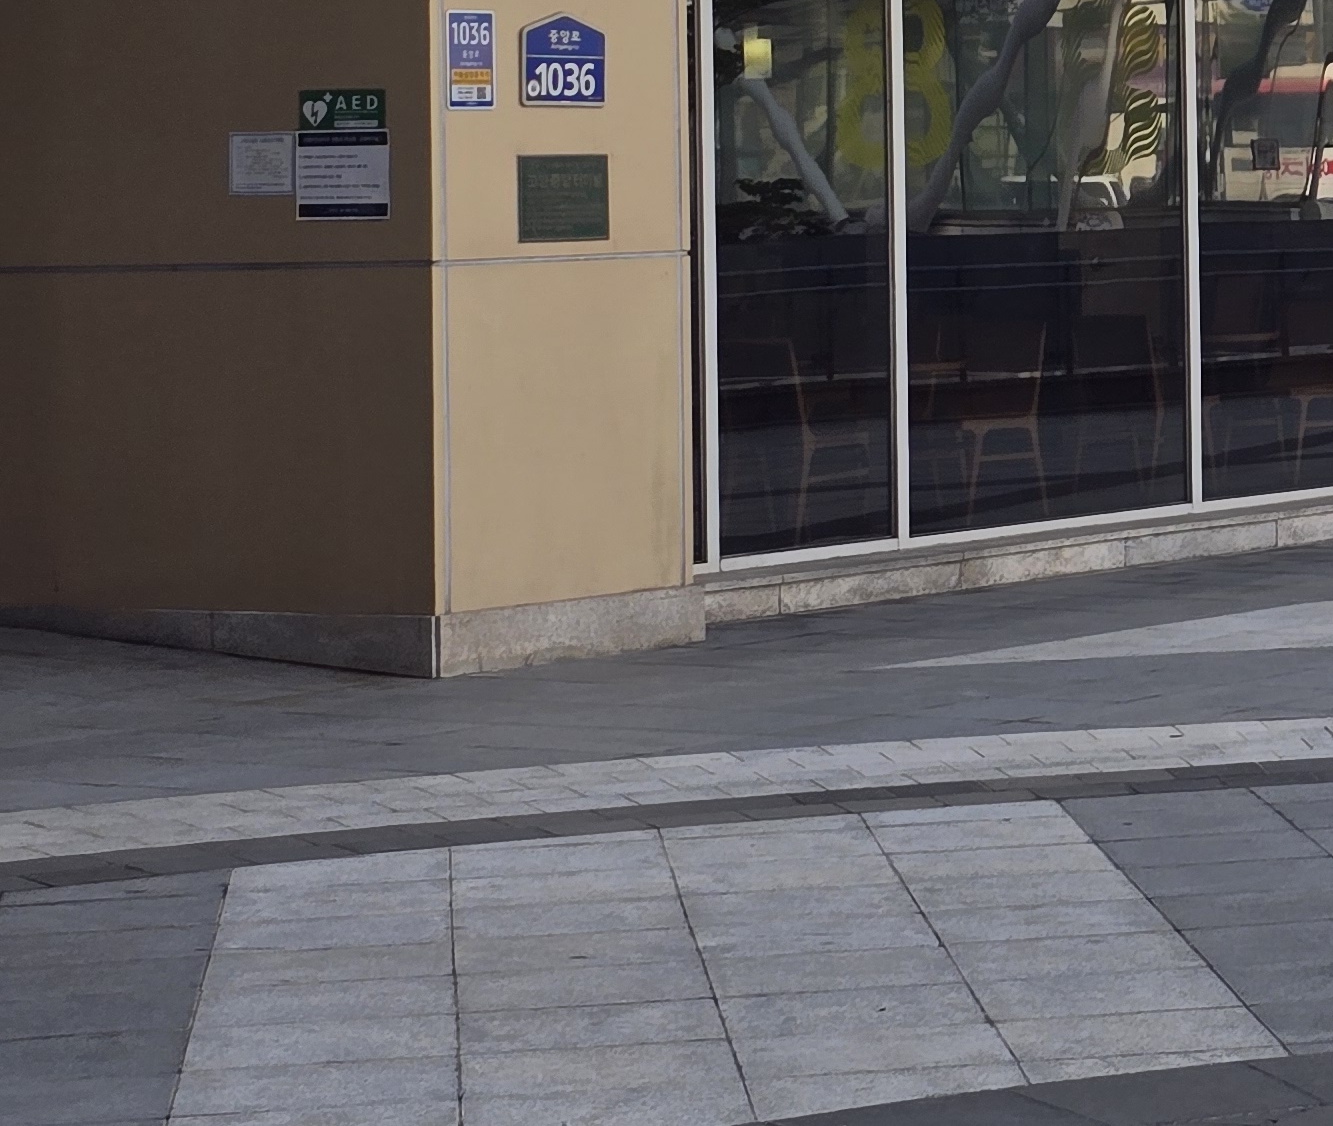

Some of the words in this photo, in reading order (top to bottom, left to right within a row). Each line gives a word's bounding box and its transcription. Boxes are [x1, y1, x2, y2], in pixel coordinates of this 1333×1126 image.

[451, 21, 490, 45] 1036
[548, 29, 582, 44] 중앙로
[534, 62, 596, 97] 1036
[335, 94, 379, 110] AED
